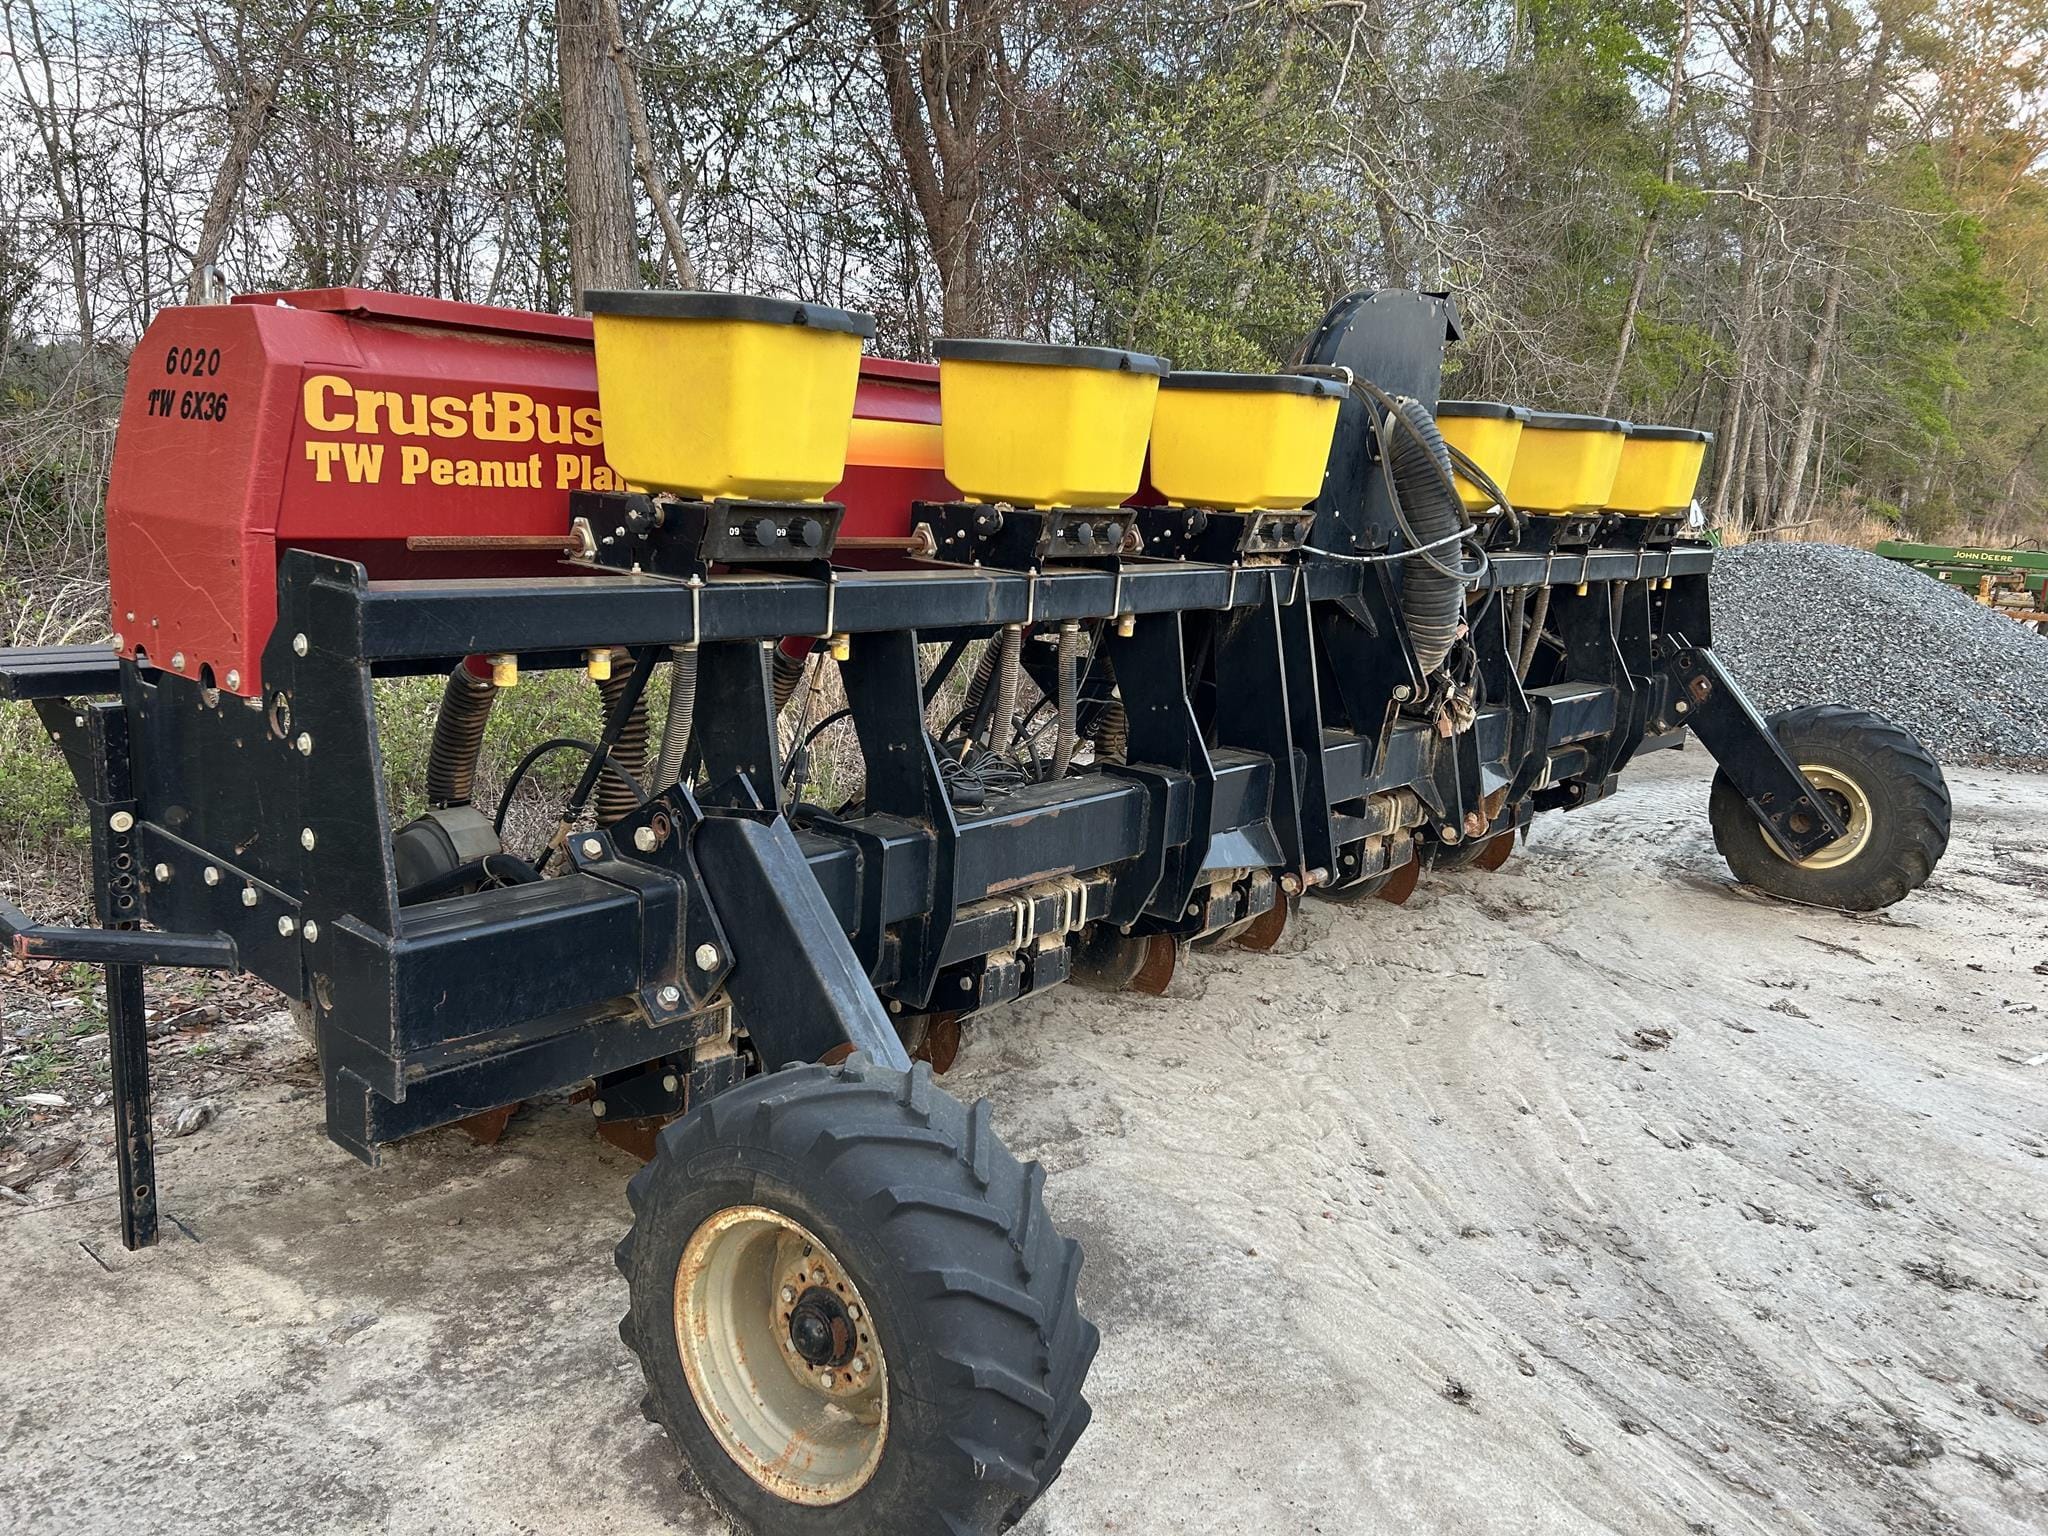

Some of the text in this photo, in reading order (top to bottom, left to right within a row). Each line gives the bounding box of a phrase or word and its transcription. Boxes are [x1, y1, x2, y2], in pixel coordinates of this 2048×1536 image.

[166, 346, 221, 377] 6020
[148, 389, 229, 422] TW 6X36
[305, 441, 384, 483] TW
[400, 446, 542, 488] Peanut
[1953, 551, 2014, 563] JOHN DEERE
